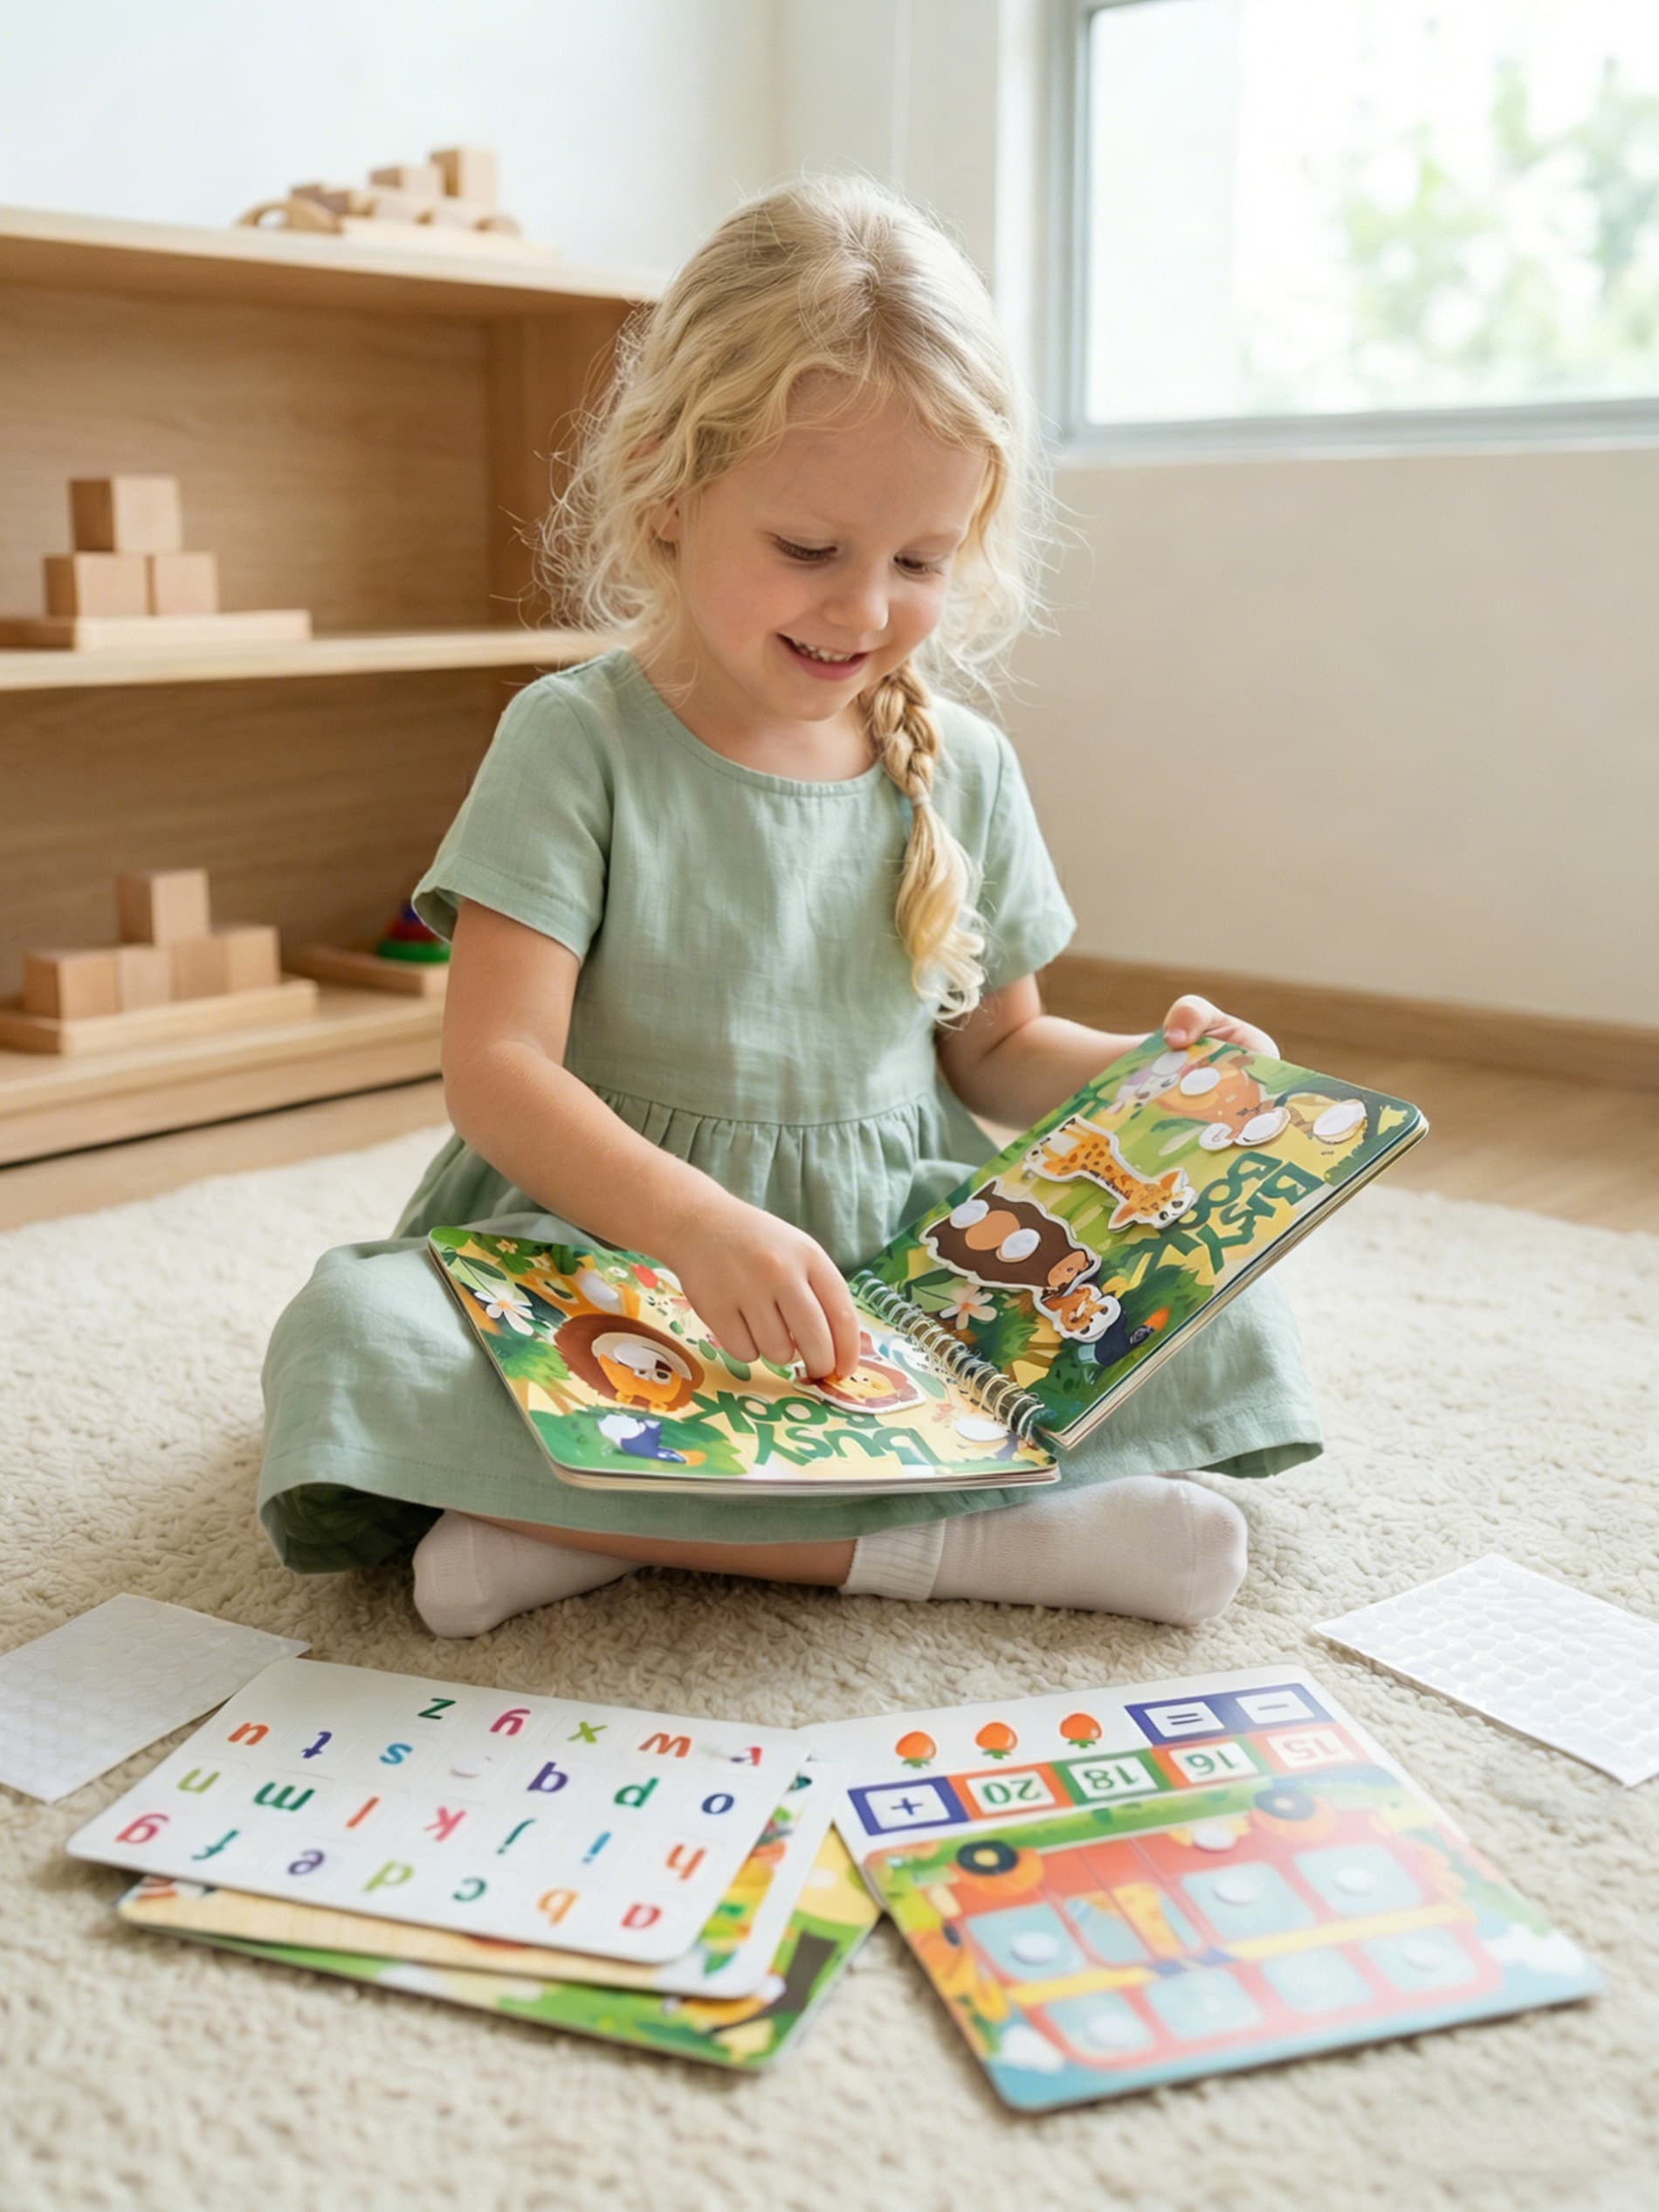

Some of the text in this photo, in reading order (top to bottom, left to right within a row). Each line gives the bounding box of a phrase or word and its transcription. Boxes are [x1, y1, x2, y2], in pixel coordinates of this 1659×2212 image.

[417, 1698, 692, 1758] w x y z
[1186, 1749, 1238, 1775] 16
[1284, 1734, 1337, 1761] 15
[176, 1768, 221, 1794] n
[227, 1722, 735, 1815] o p q s t u
[1084, 1764, 1139, 1790] 18
[253, 1781, 315, 1812] m
[981, 1776, 1041, 1805] 20
[423, 1806, 466, 1842] k
[497, 1818, 536, 1855] j
[582, 1831, 612, 1864] i
[665, 1843, 706, 1881] h
[115, 1813, 663, 1929] a b c d e f g
